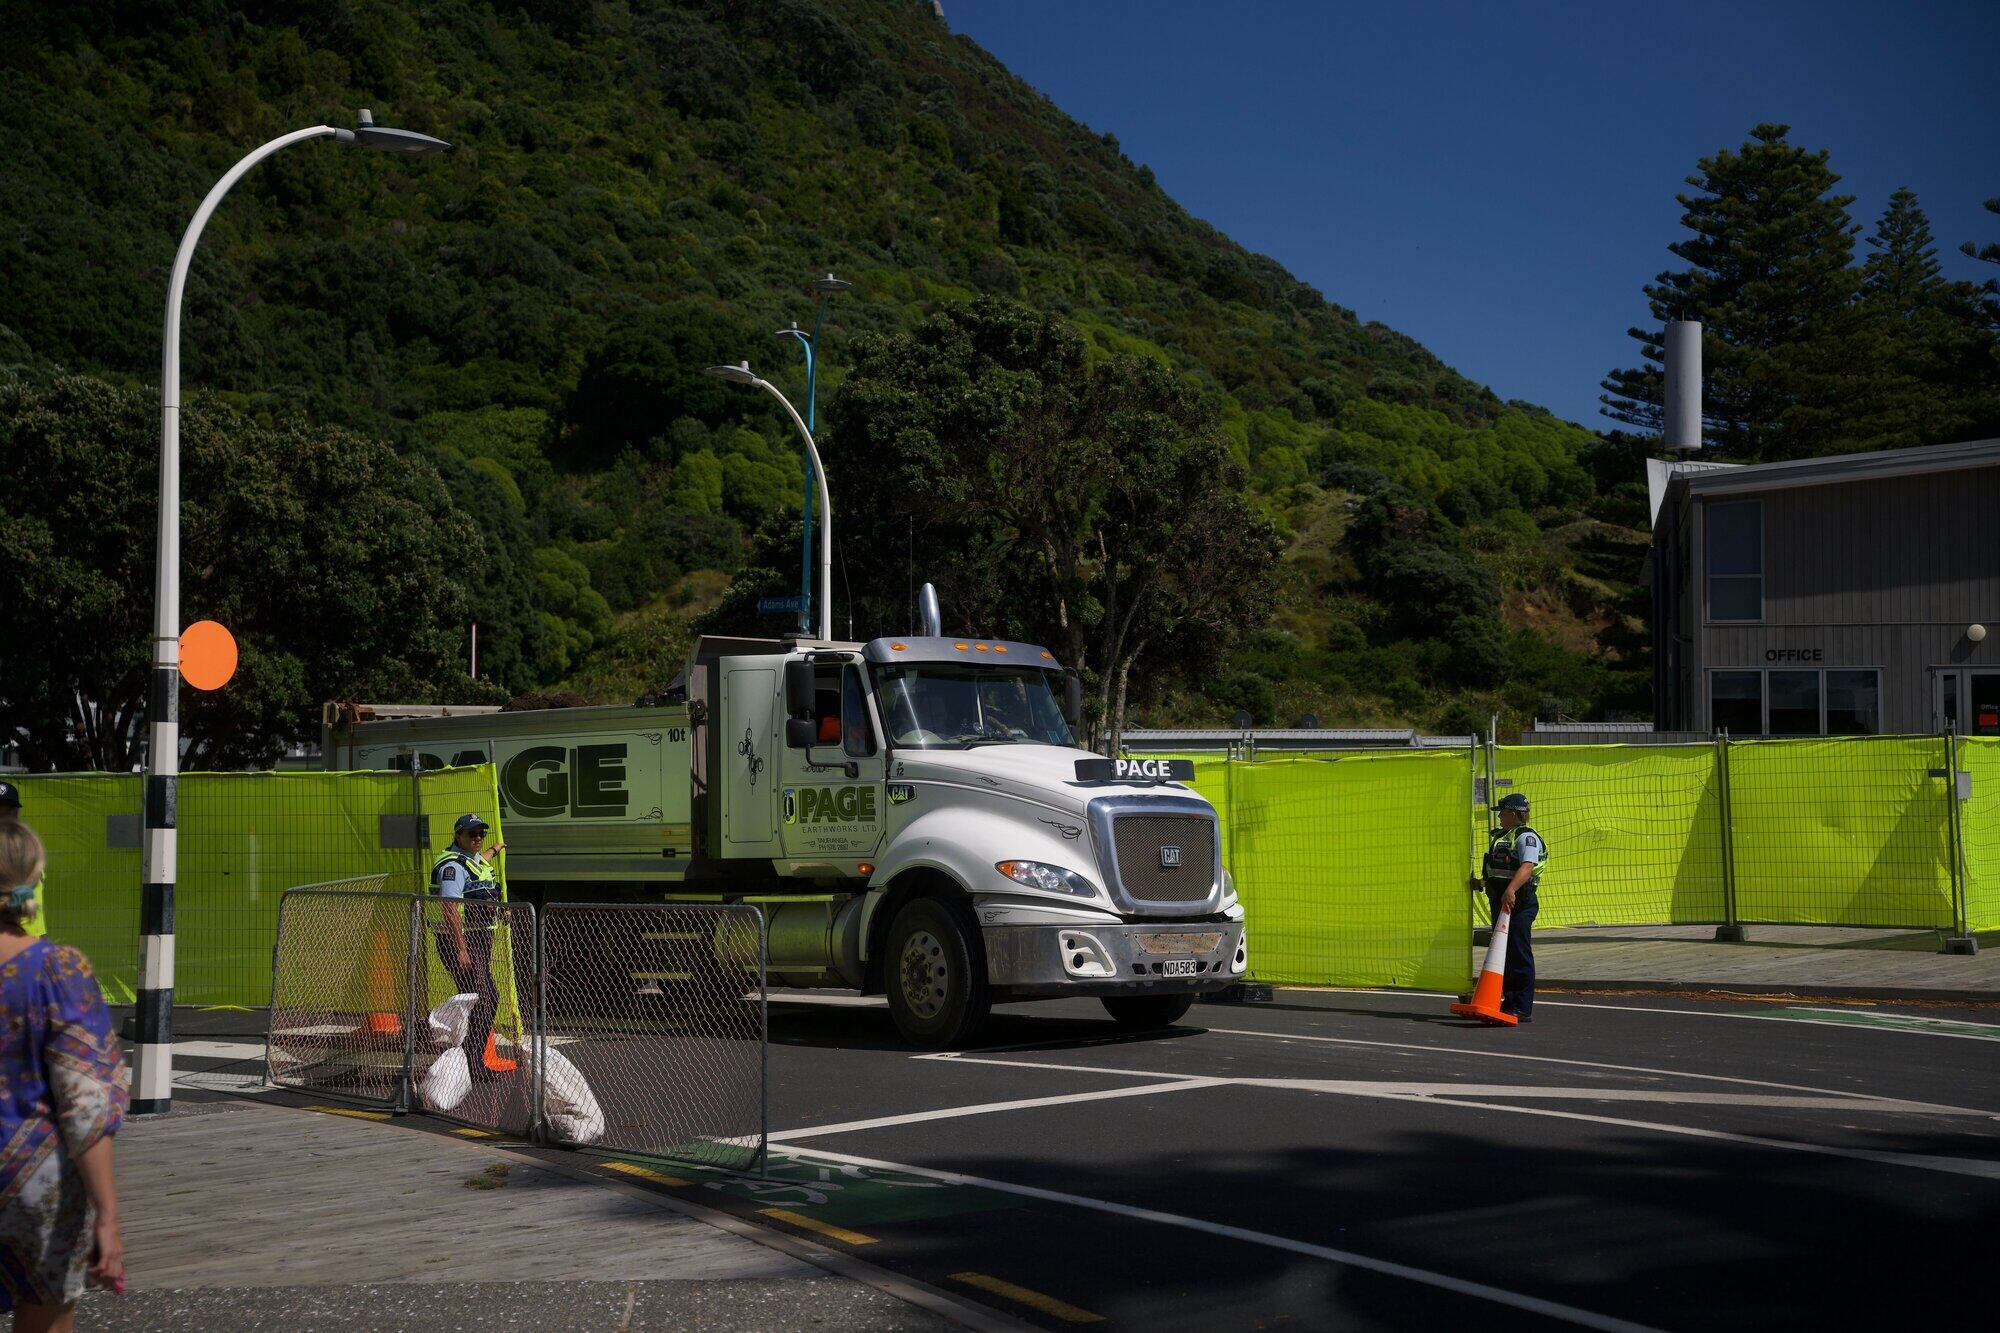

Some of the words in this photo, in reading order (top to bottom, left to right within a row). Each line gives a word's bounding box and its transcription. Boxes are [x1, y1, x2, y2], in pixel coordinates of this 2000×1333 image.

[763, 599, 784, 609] Adams
[1765, 649, 1823, 662] OFFICE
[667, 728, 686, 743] 10t
[1115, 760, 1171, 777] PAGE
[388, 743, 629, 818] GE
[892, 786, 910, 801] CAT
[799, 786, 876, 823] PAGE
[802, 825, 858, 834] EARTHWORKS
[862, 824, 877, 832] LTD
[1163, 849, 1180, 864] CAT
